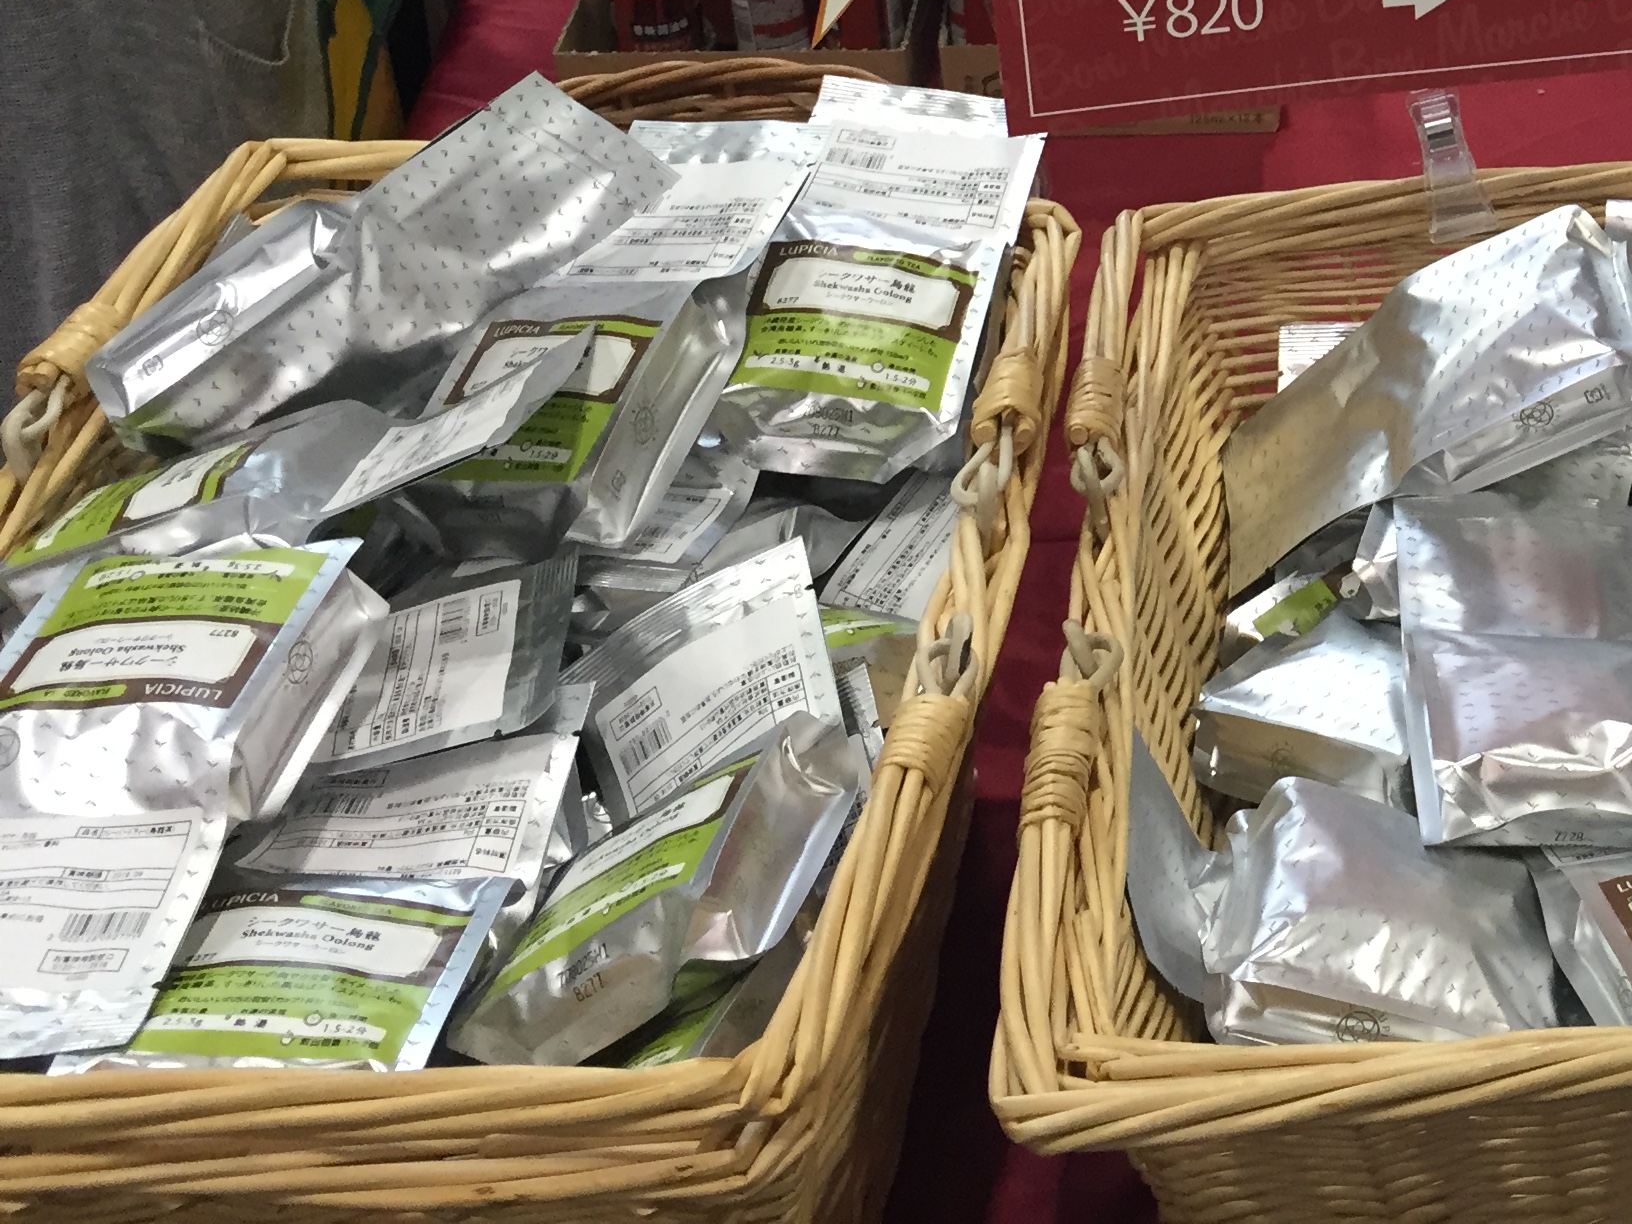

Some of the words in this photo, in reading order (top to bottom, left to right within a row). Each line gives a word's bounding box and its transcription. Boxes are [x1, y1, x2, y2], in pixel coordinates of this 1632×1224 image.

[779, 244, 839, 257] LUPICIA
[144, 682, 223, 701] LUPICIA
[239, 928, 319, 942] Shekwasha
[320, 934, 377, 953] Oolong
